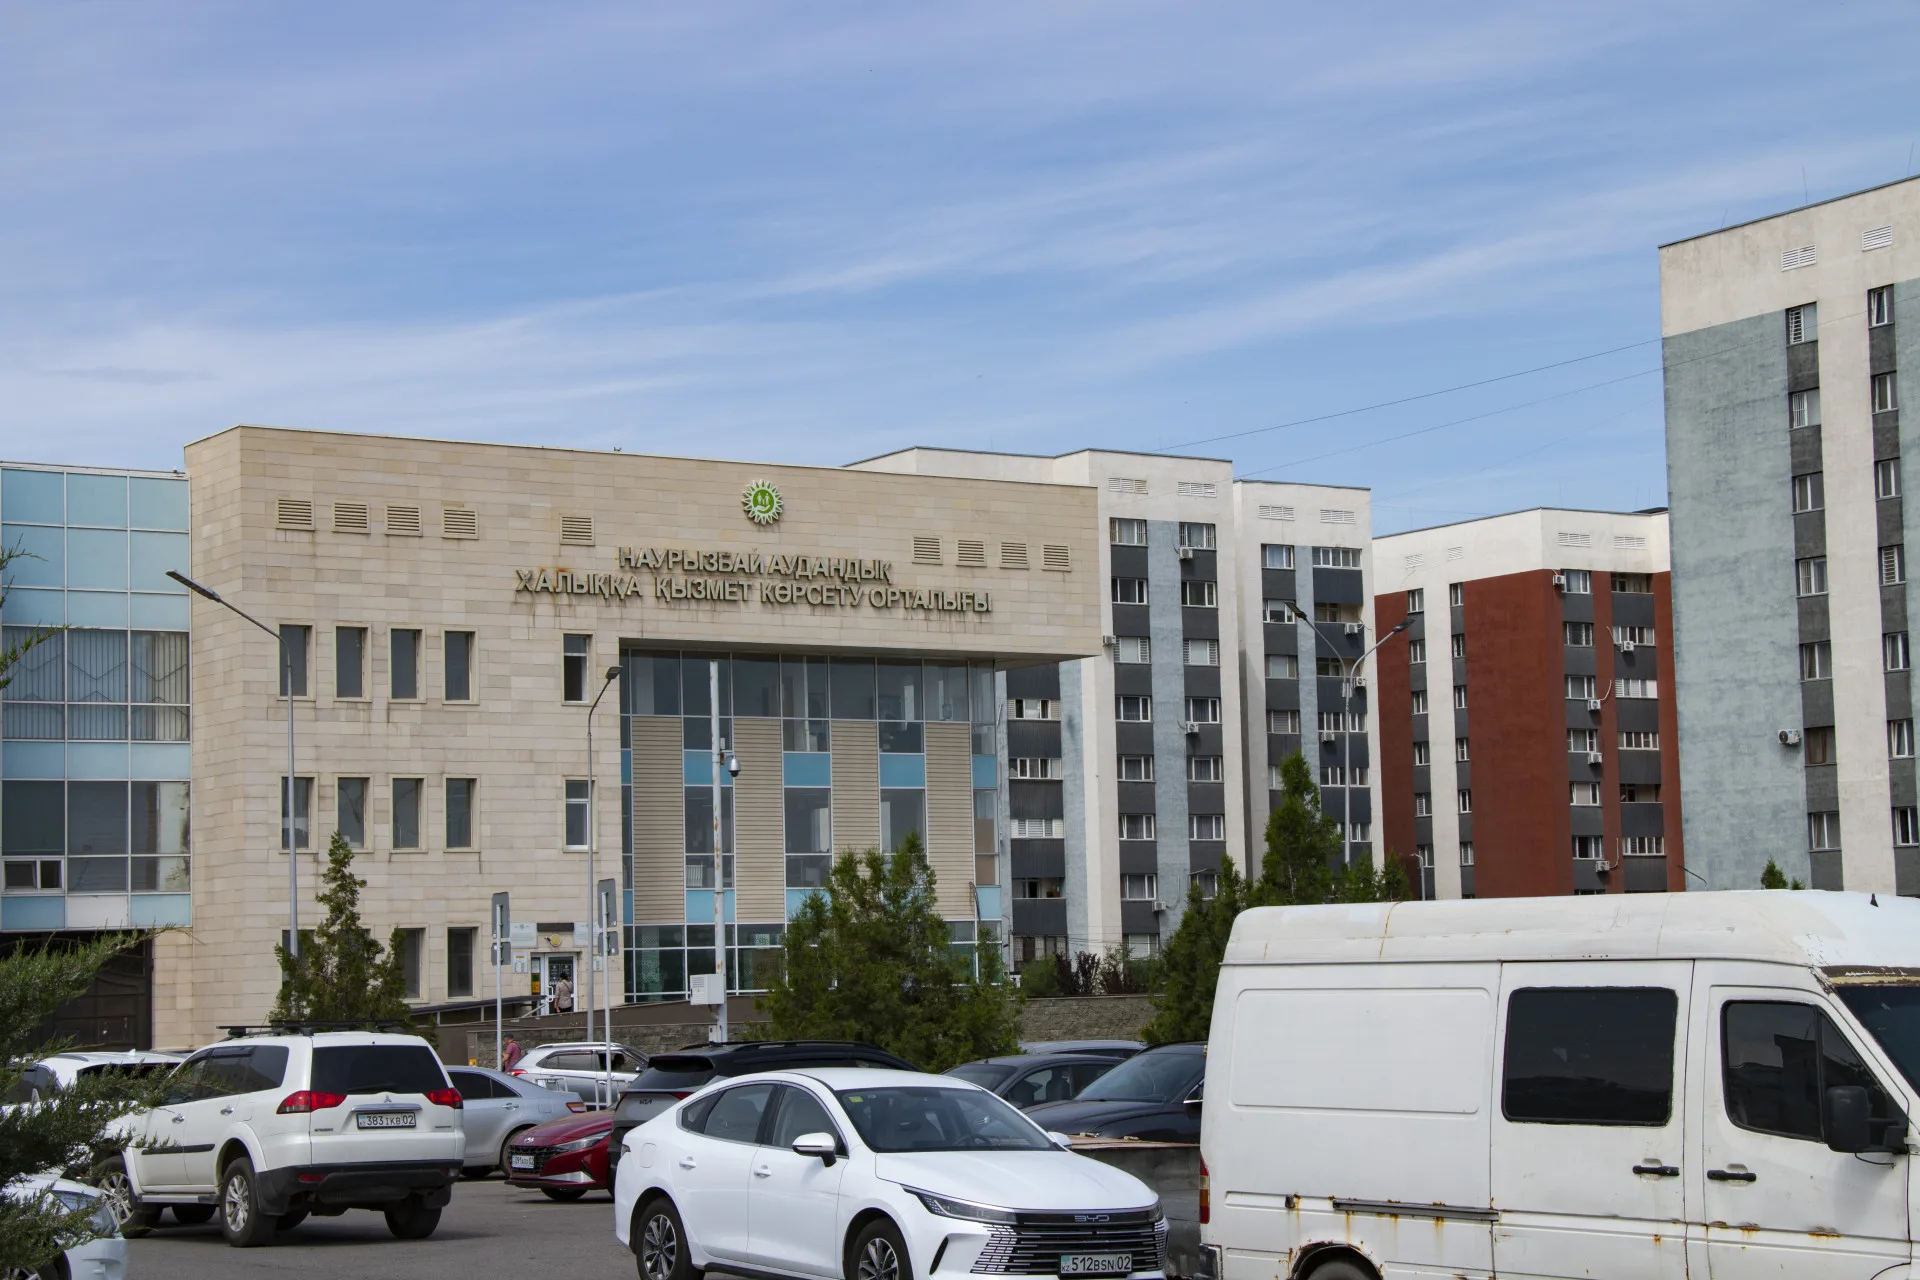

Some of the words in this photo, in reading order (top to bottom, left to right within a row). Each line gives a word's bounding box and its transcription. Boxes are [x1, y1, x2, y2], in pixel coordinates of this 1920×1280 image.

[618, 547, 764, 575] НАУРЫЗБАЙ
[768, 554, 893, 584] АУДАНДЫҚ
[516, 569, 642, 600] ХАЛЫҚҚА
[655, 577, 754, 602] ҚЫЗМЕТ
[760, 582, 864, 606] КӨРСЕТУ
[869, 588, 993, 613] ОРТАЛЫҒЫ
[402, 1114, 414, 1125] 02
[1116, 1256, 1131, 1270] 02
